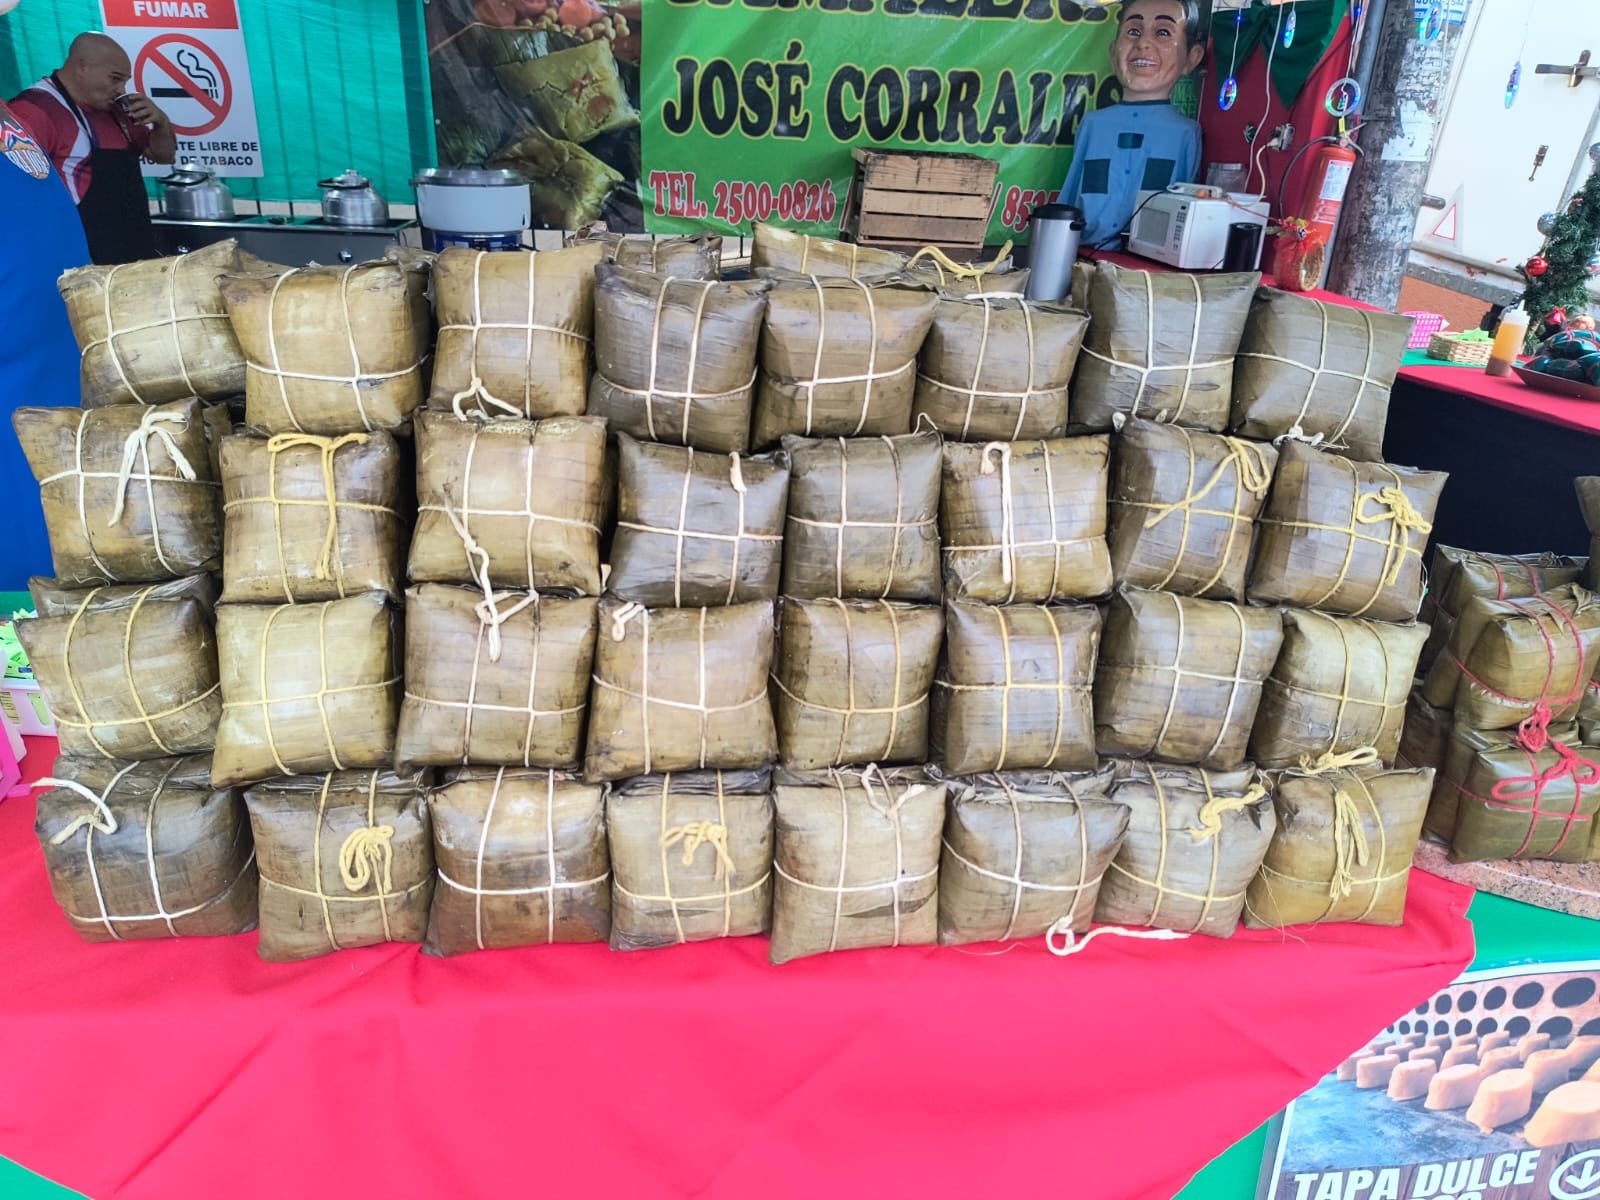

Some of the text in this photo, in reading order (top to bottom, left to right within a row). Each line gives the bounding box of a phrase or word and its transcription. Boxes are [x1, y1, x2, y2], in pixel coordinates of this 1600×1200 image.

[133, 1, 209, 19] FUMAR
[661, 38, 812, 142] JOSÉ
[199, 141, 238, 152] LIBRE
[241, 142, 259, 152] DE
[201, 155, 253, 166] TABACO
[649, 169, 708, 219] TEL.
[713, 178, 836, 225] 2500-0826
[1294, 1149, 1542, 1200] TAPA DULCE
